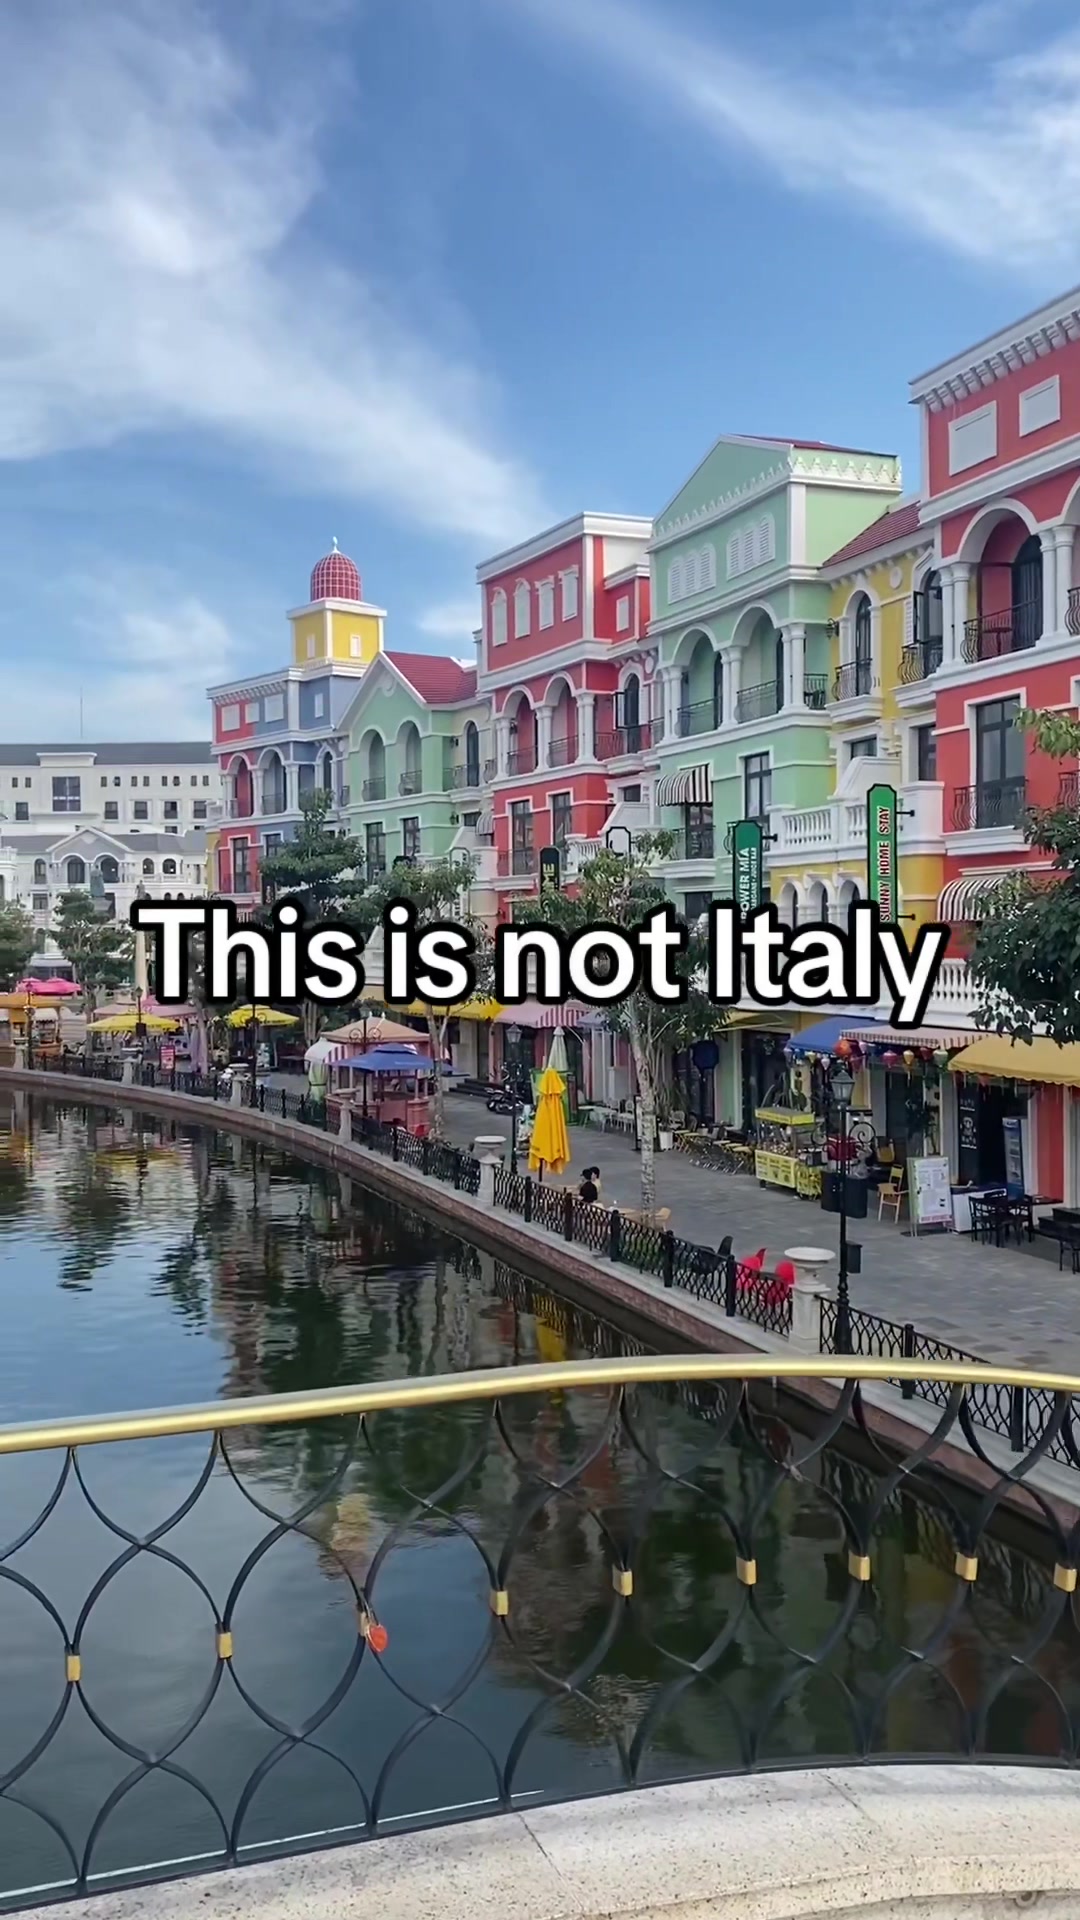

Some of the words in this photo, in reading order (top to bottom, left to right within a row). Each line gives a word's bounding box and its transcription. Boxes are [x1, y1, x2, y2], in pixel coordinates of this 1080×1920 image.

[876, 805, 891, 836] STAY
[876, 840, 891, 877] HOME
[877, 880, 892, 922] SUNNY
